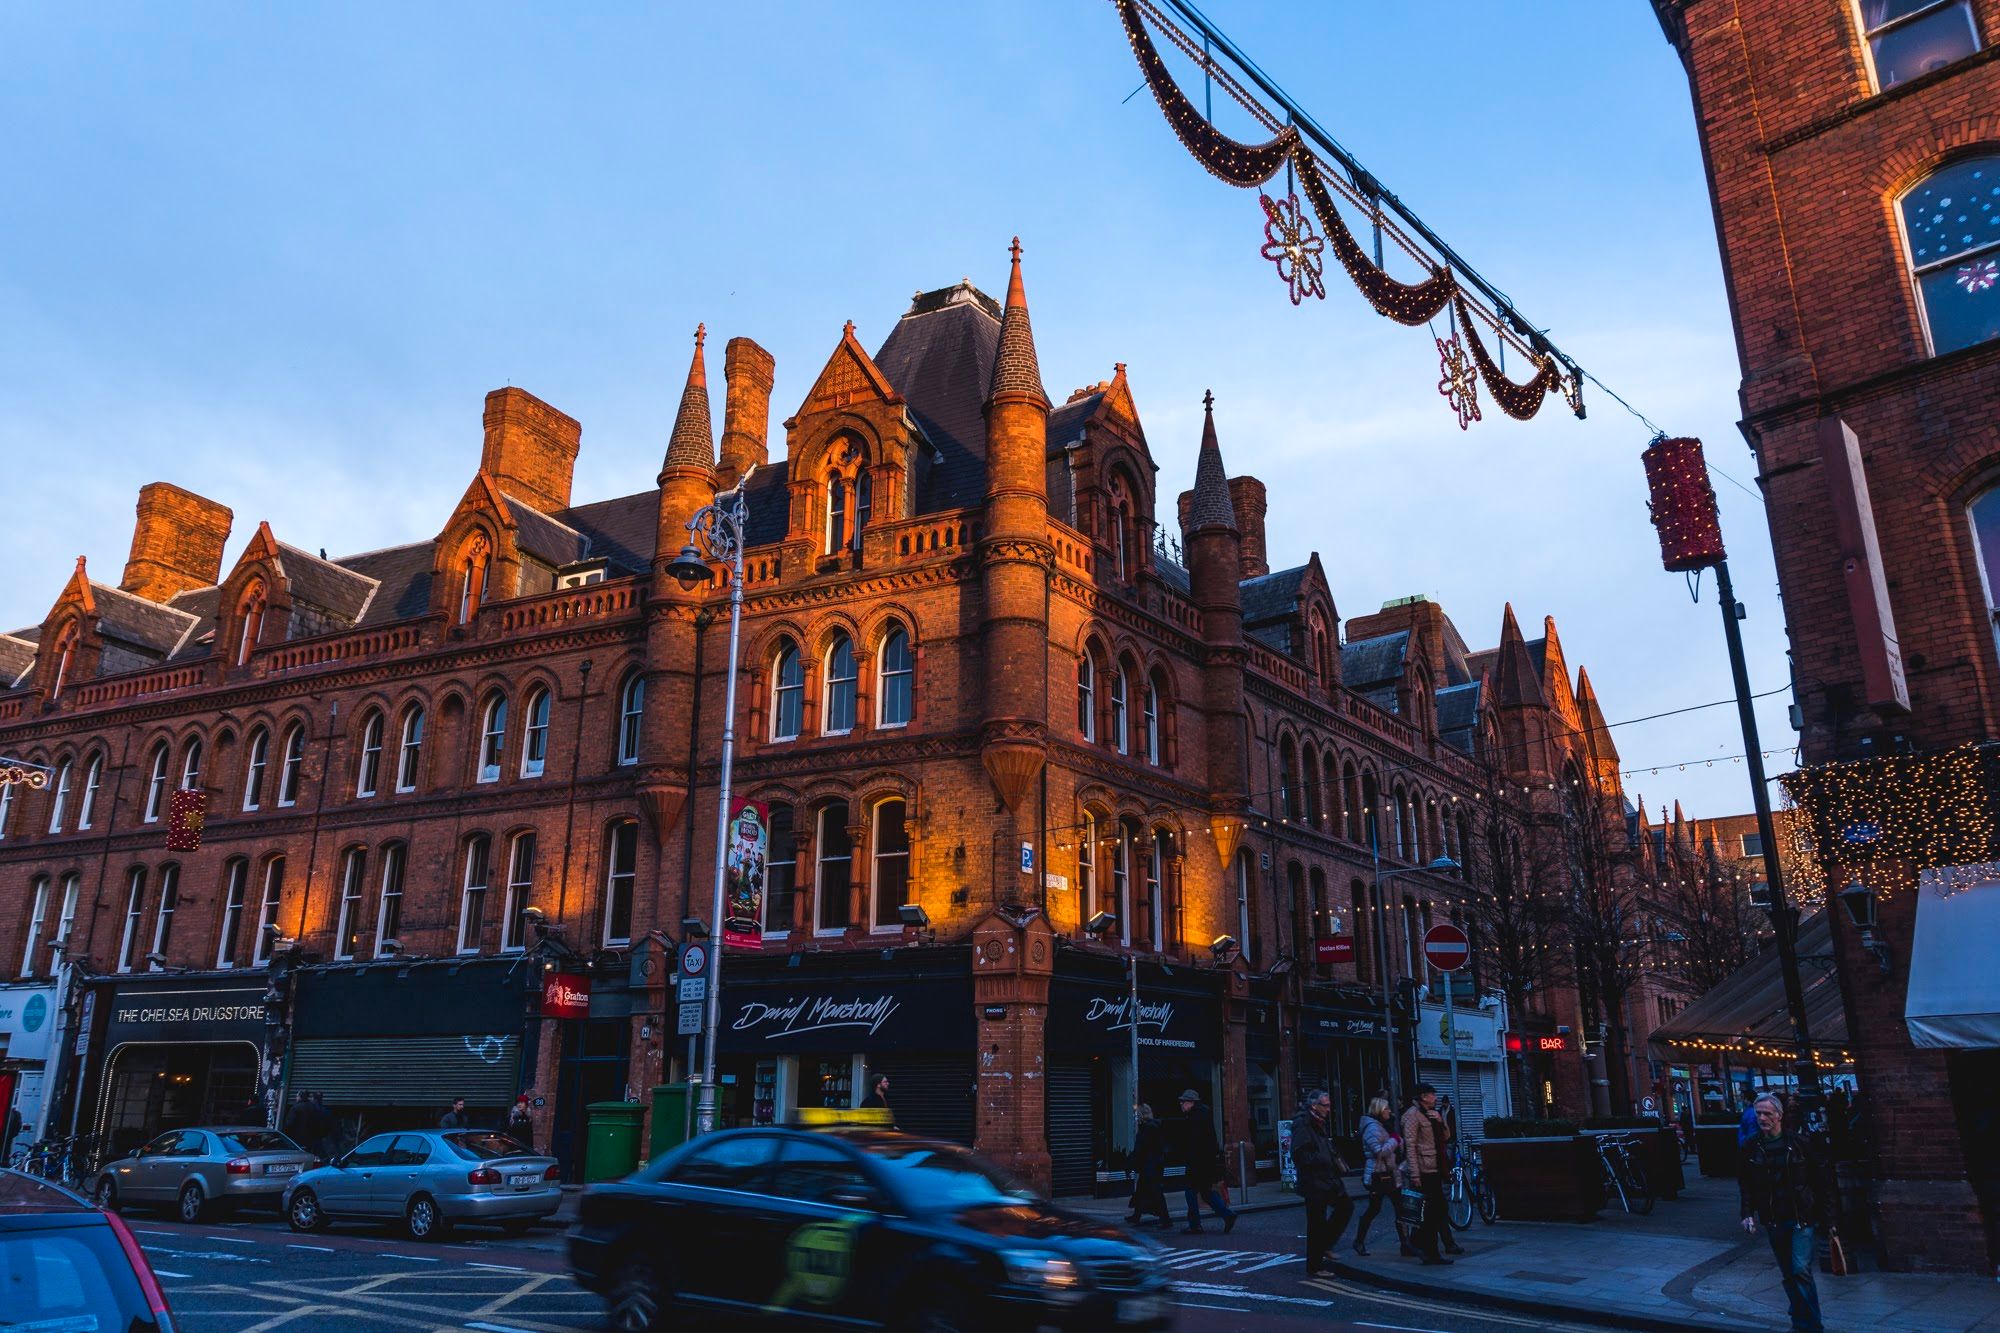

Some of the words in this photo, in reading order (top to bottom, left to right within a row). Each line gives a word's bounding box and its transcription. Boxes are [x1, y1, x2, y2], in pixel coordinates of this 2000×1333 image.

[687, 959, 703, 968] TAXI
[564, 992, 589, 1002] Grafton
[118, 1009, 138, 1023] THE
[140, 1007, 190, 1022] CHELSEA
[192, 1005, 265, 1021] DRUGSTORE
[732, 996, 810, 1032] David
[806, 995, 901, 1036] Marshall
[1086, 996, 1130, 1025] David
[1136, 1037, 1154, 1046] CHOOL
[1154, 1038, 1162, 1046] OF
[1541, 1038, 1562, 1049] BAR
